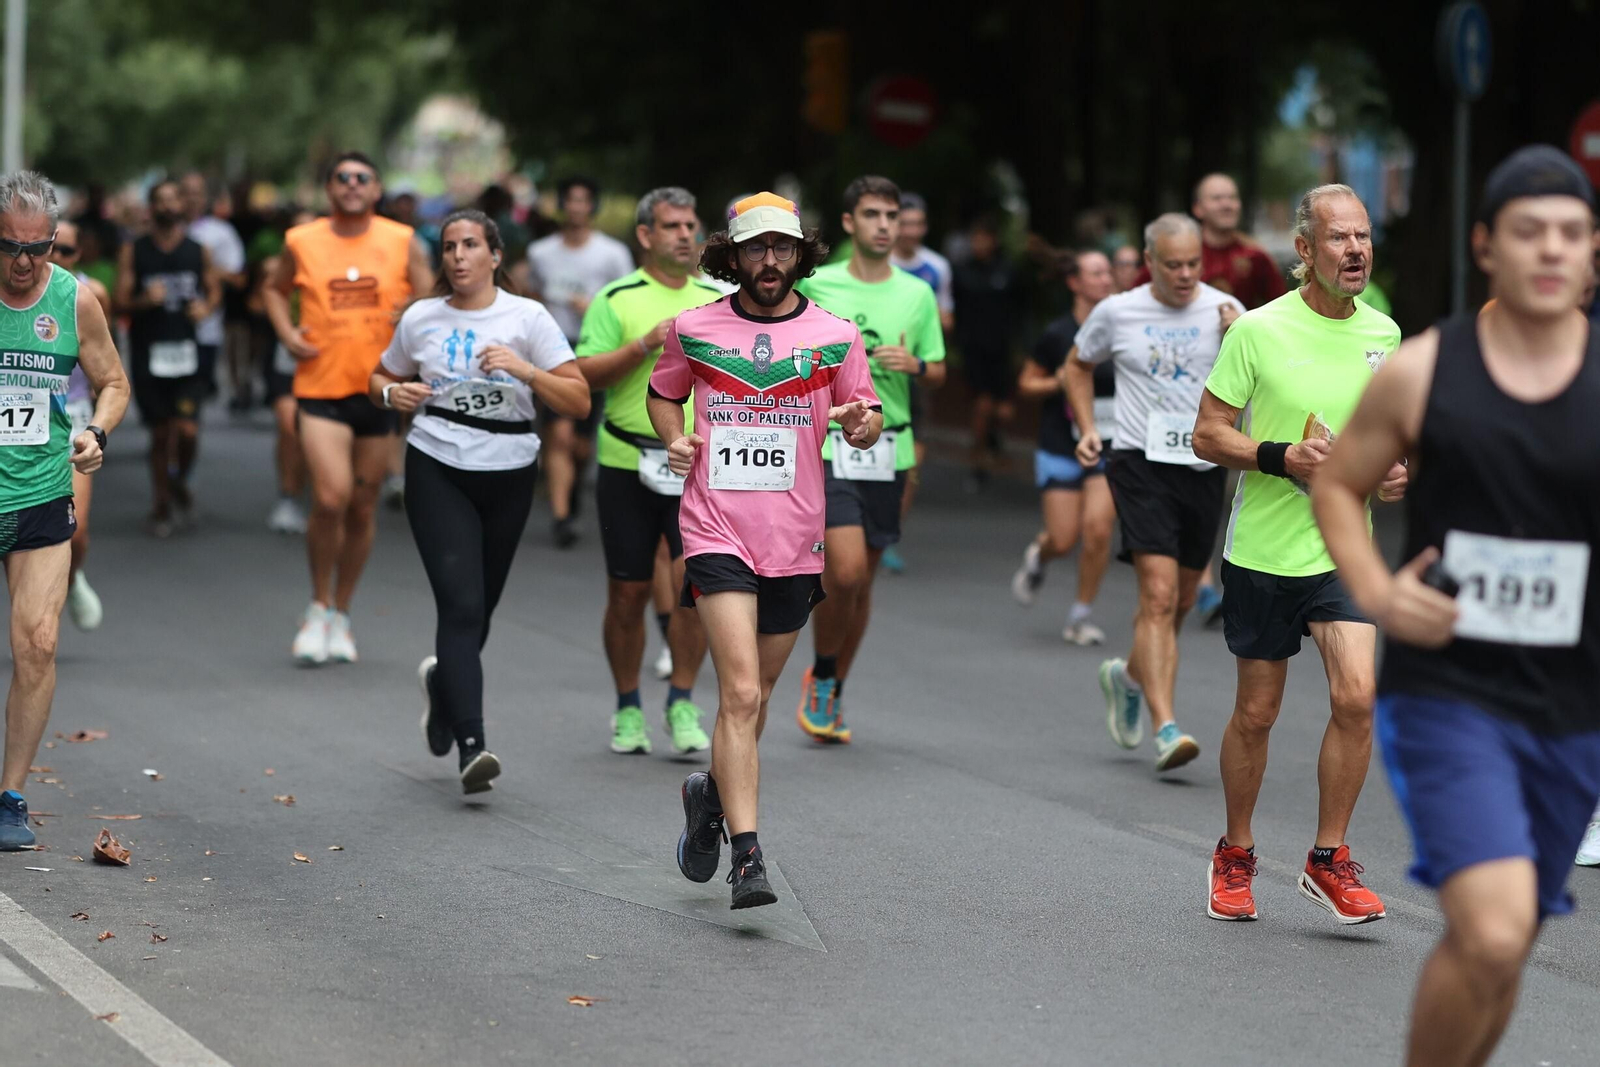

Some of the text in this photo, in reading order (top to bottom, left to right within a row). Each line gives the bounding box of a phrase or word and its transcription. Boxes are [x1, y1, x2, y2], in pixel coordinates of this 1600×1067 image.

[0, 352, 55, 370] ETISMO
[708, 347, 740, 357] capelli
[454, 390, 504, 413] 533
[707, 392, 774, 408] فلسطين
[737, 411, 754, 423] OF
[718, 447, 785, 467] 1106
[1466, 571, 1557, 609] 199
